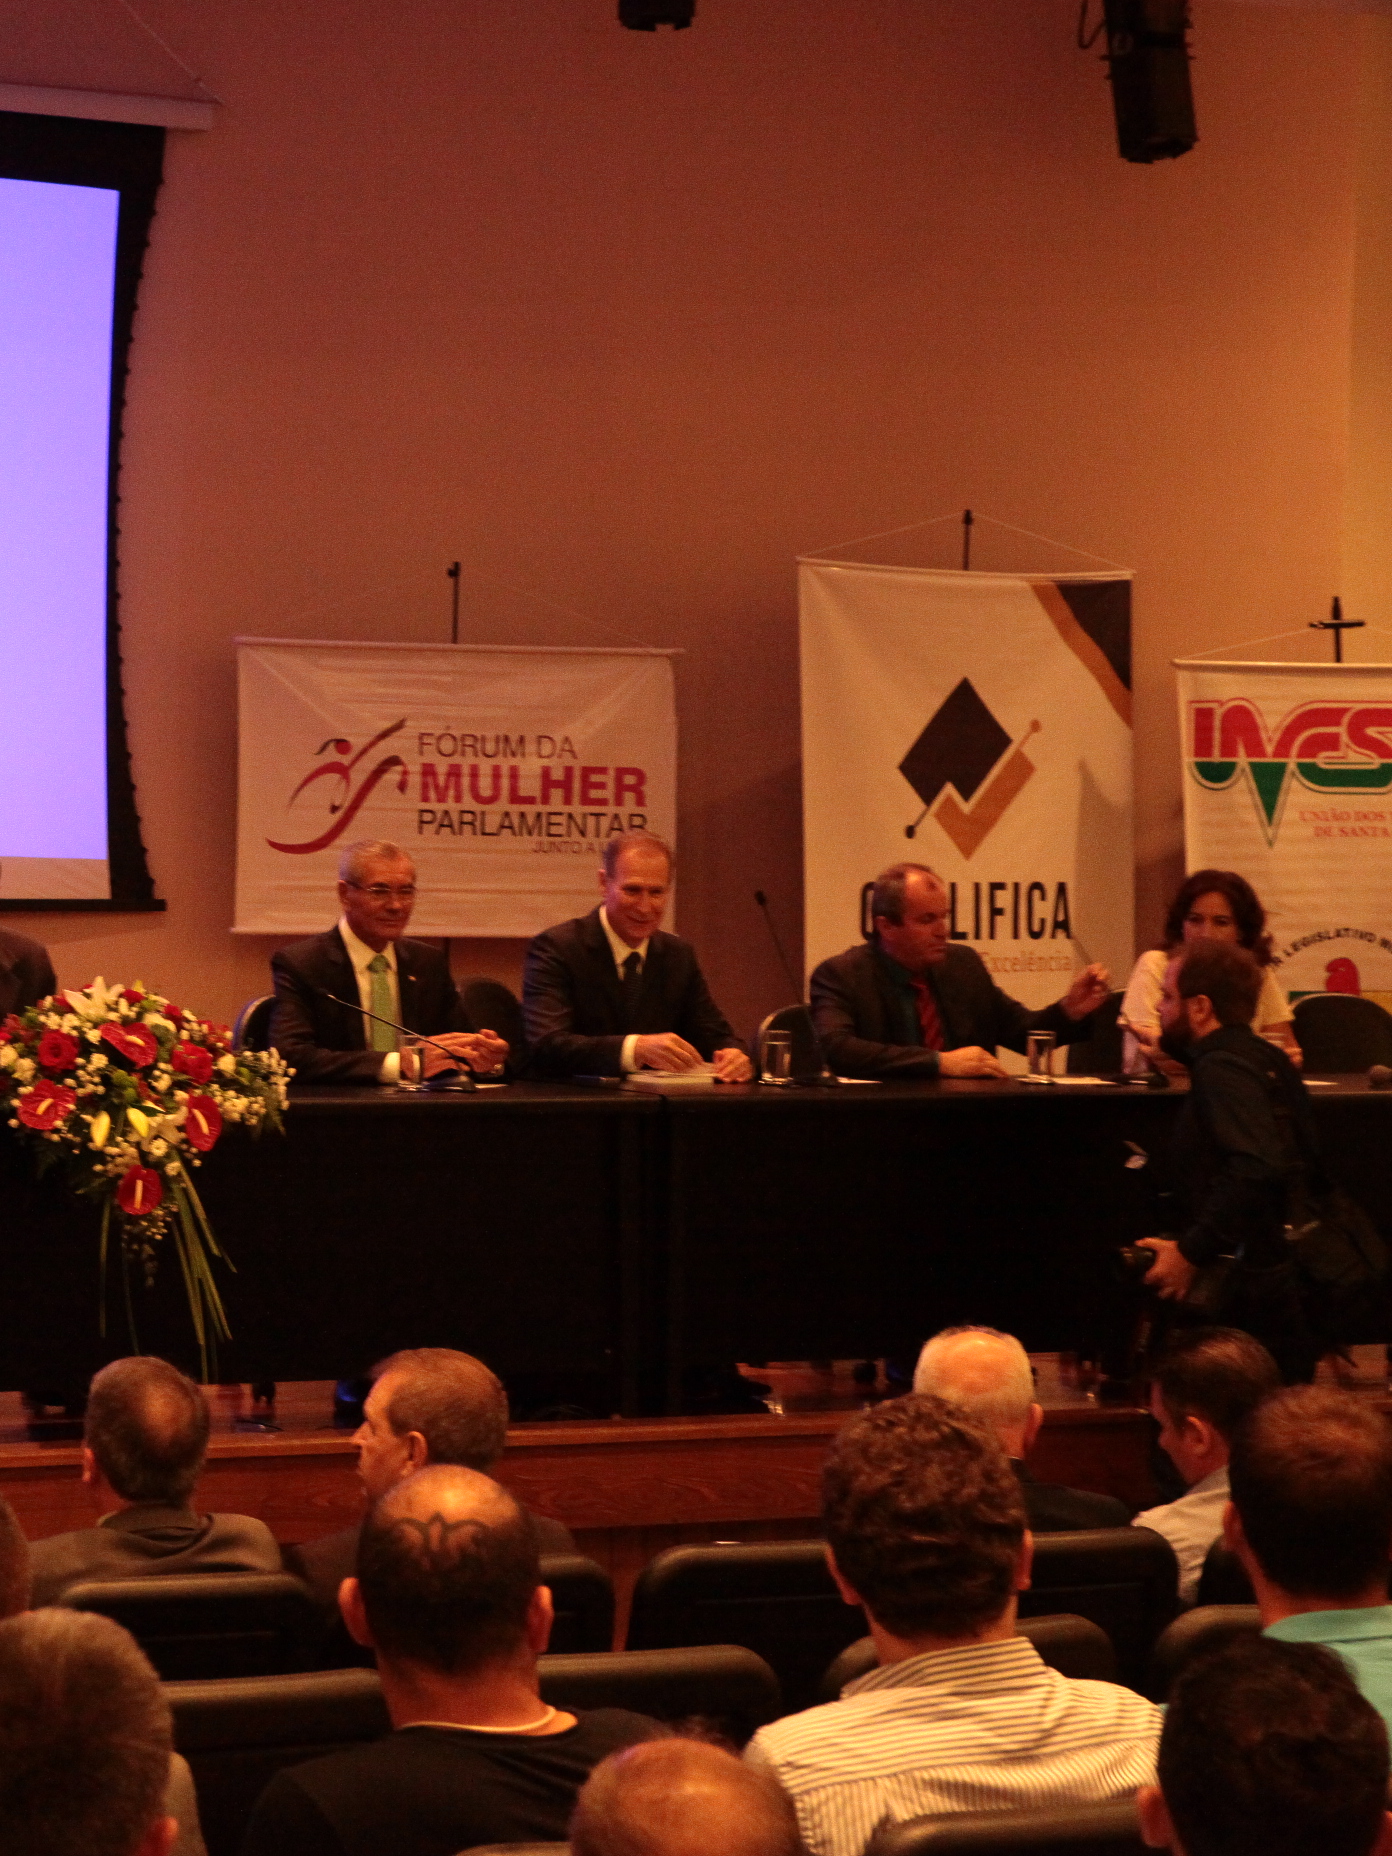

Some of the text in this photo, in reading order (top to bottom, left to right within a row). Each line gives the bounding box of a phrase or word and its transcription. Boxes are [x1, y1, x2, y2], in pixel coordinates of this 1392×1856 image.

[417, 725, 577, 759] FÓRUM DA
[420, 762, 647, 807] MULHER
[417, 808, 648, 838] PARLAMENTAR
[860, 881, 1072, 940] QLIFICA
